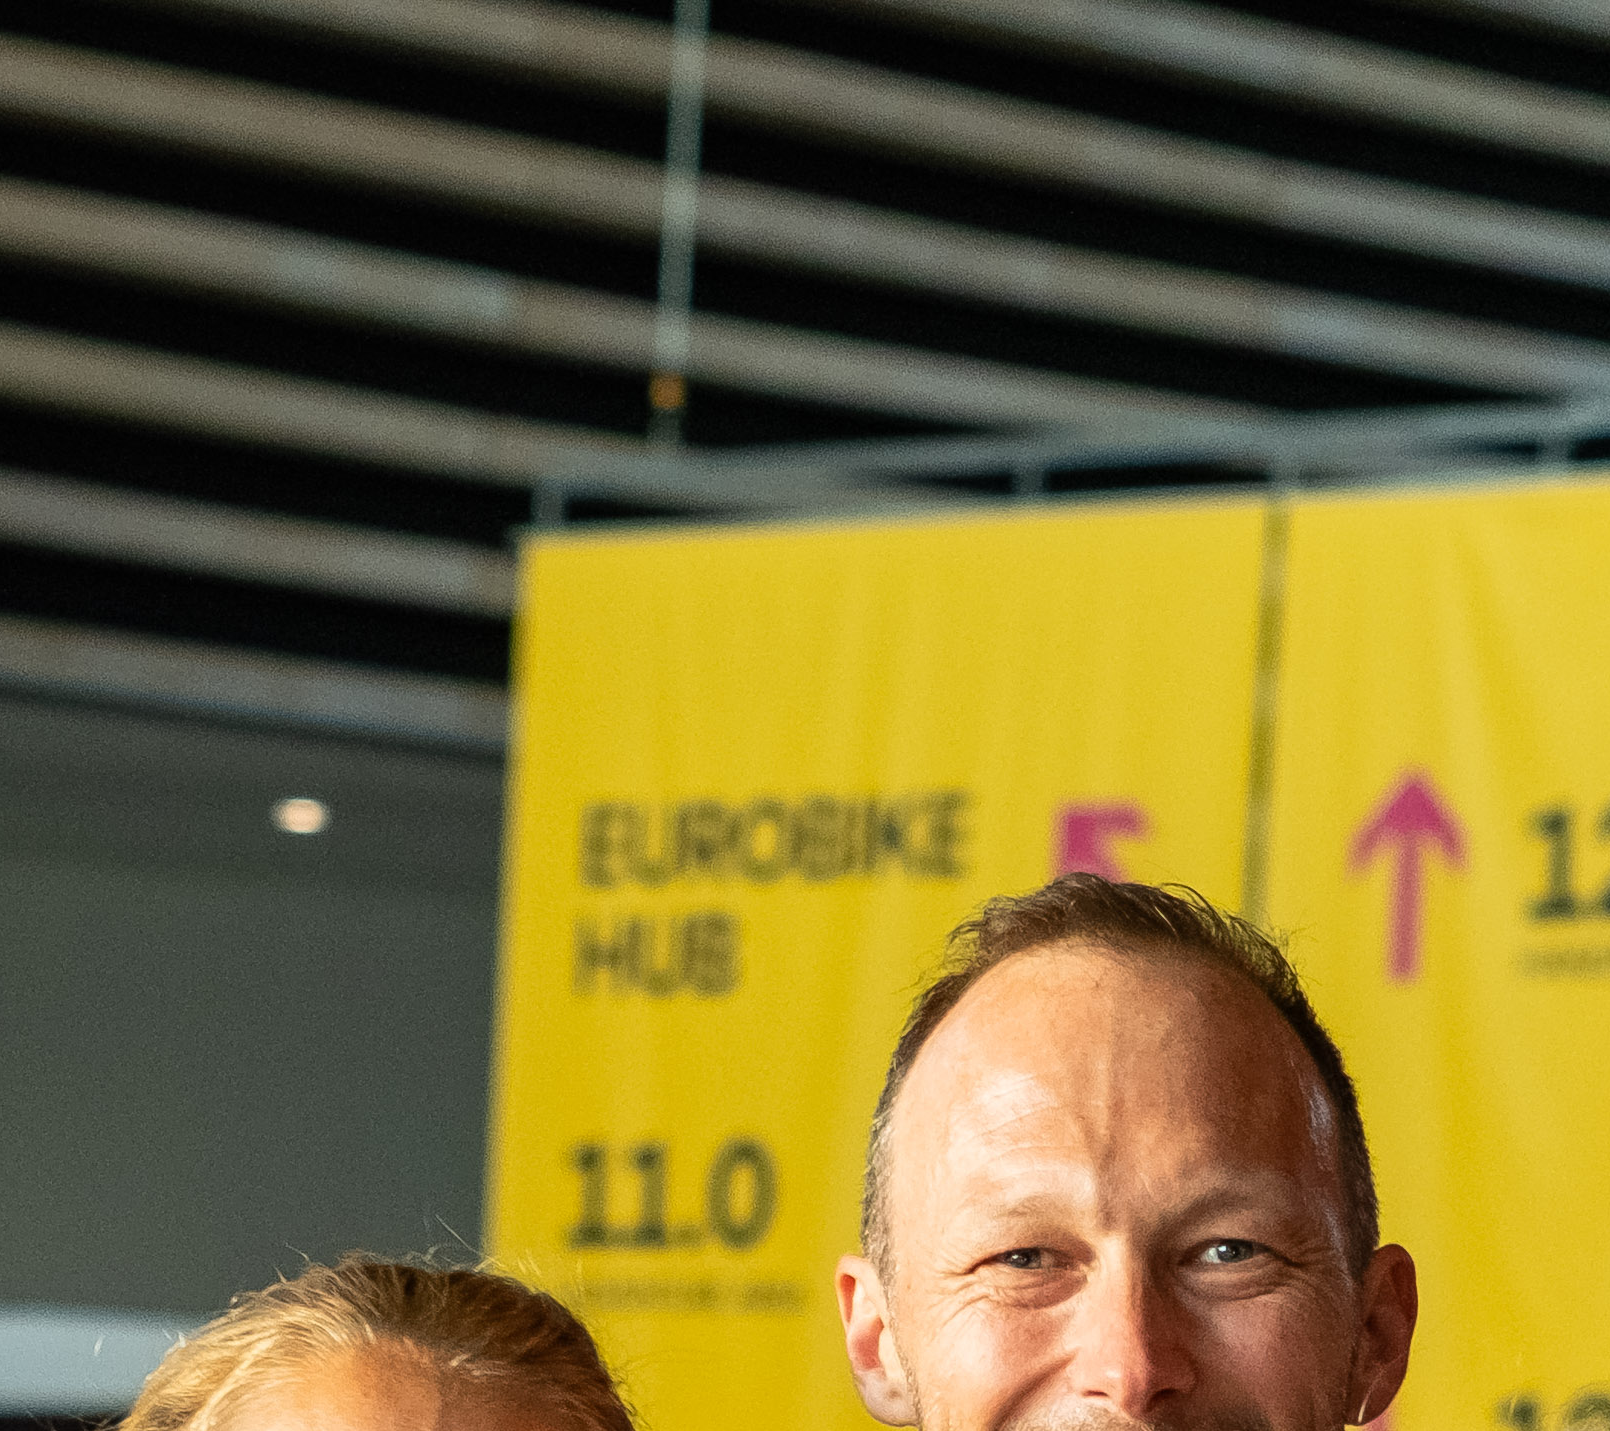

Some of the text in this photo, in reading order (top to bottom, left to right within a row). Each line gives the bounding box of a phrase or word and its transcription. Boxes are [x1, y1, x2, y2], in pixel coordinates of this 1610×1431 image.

[580, 790, 970, 888] EUROBIKE
[573, 911, 742, 999] HUB
[565, 1136, 780, 1251] 11.0
